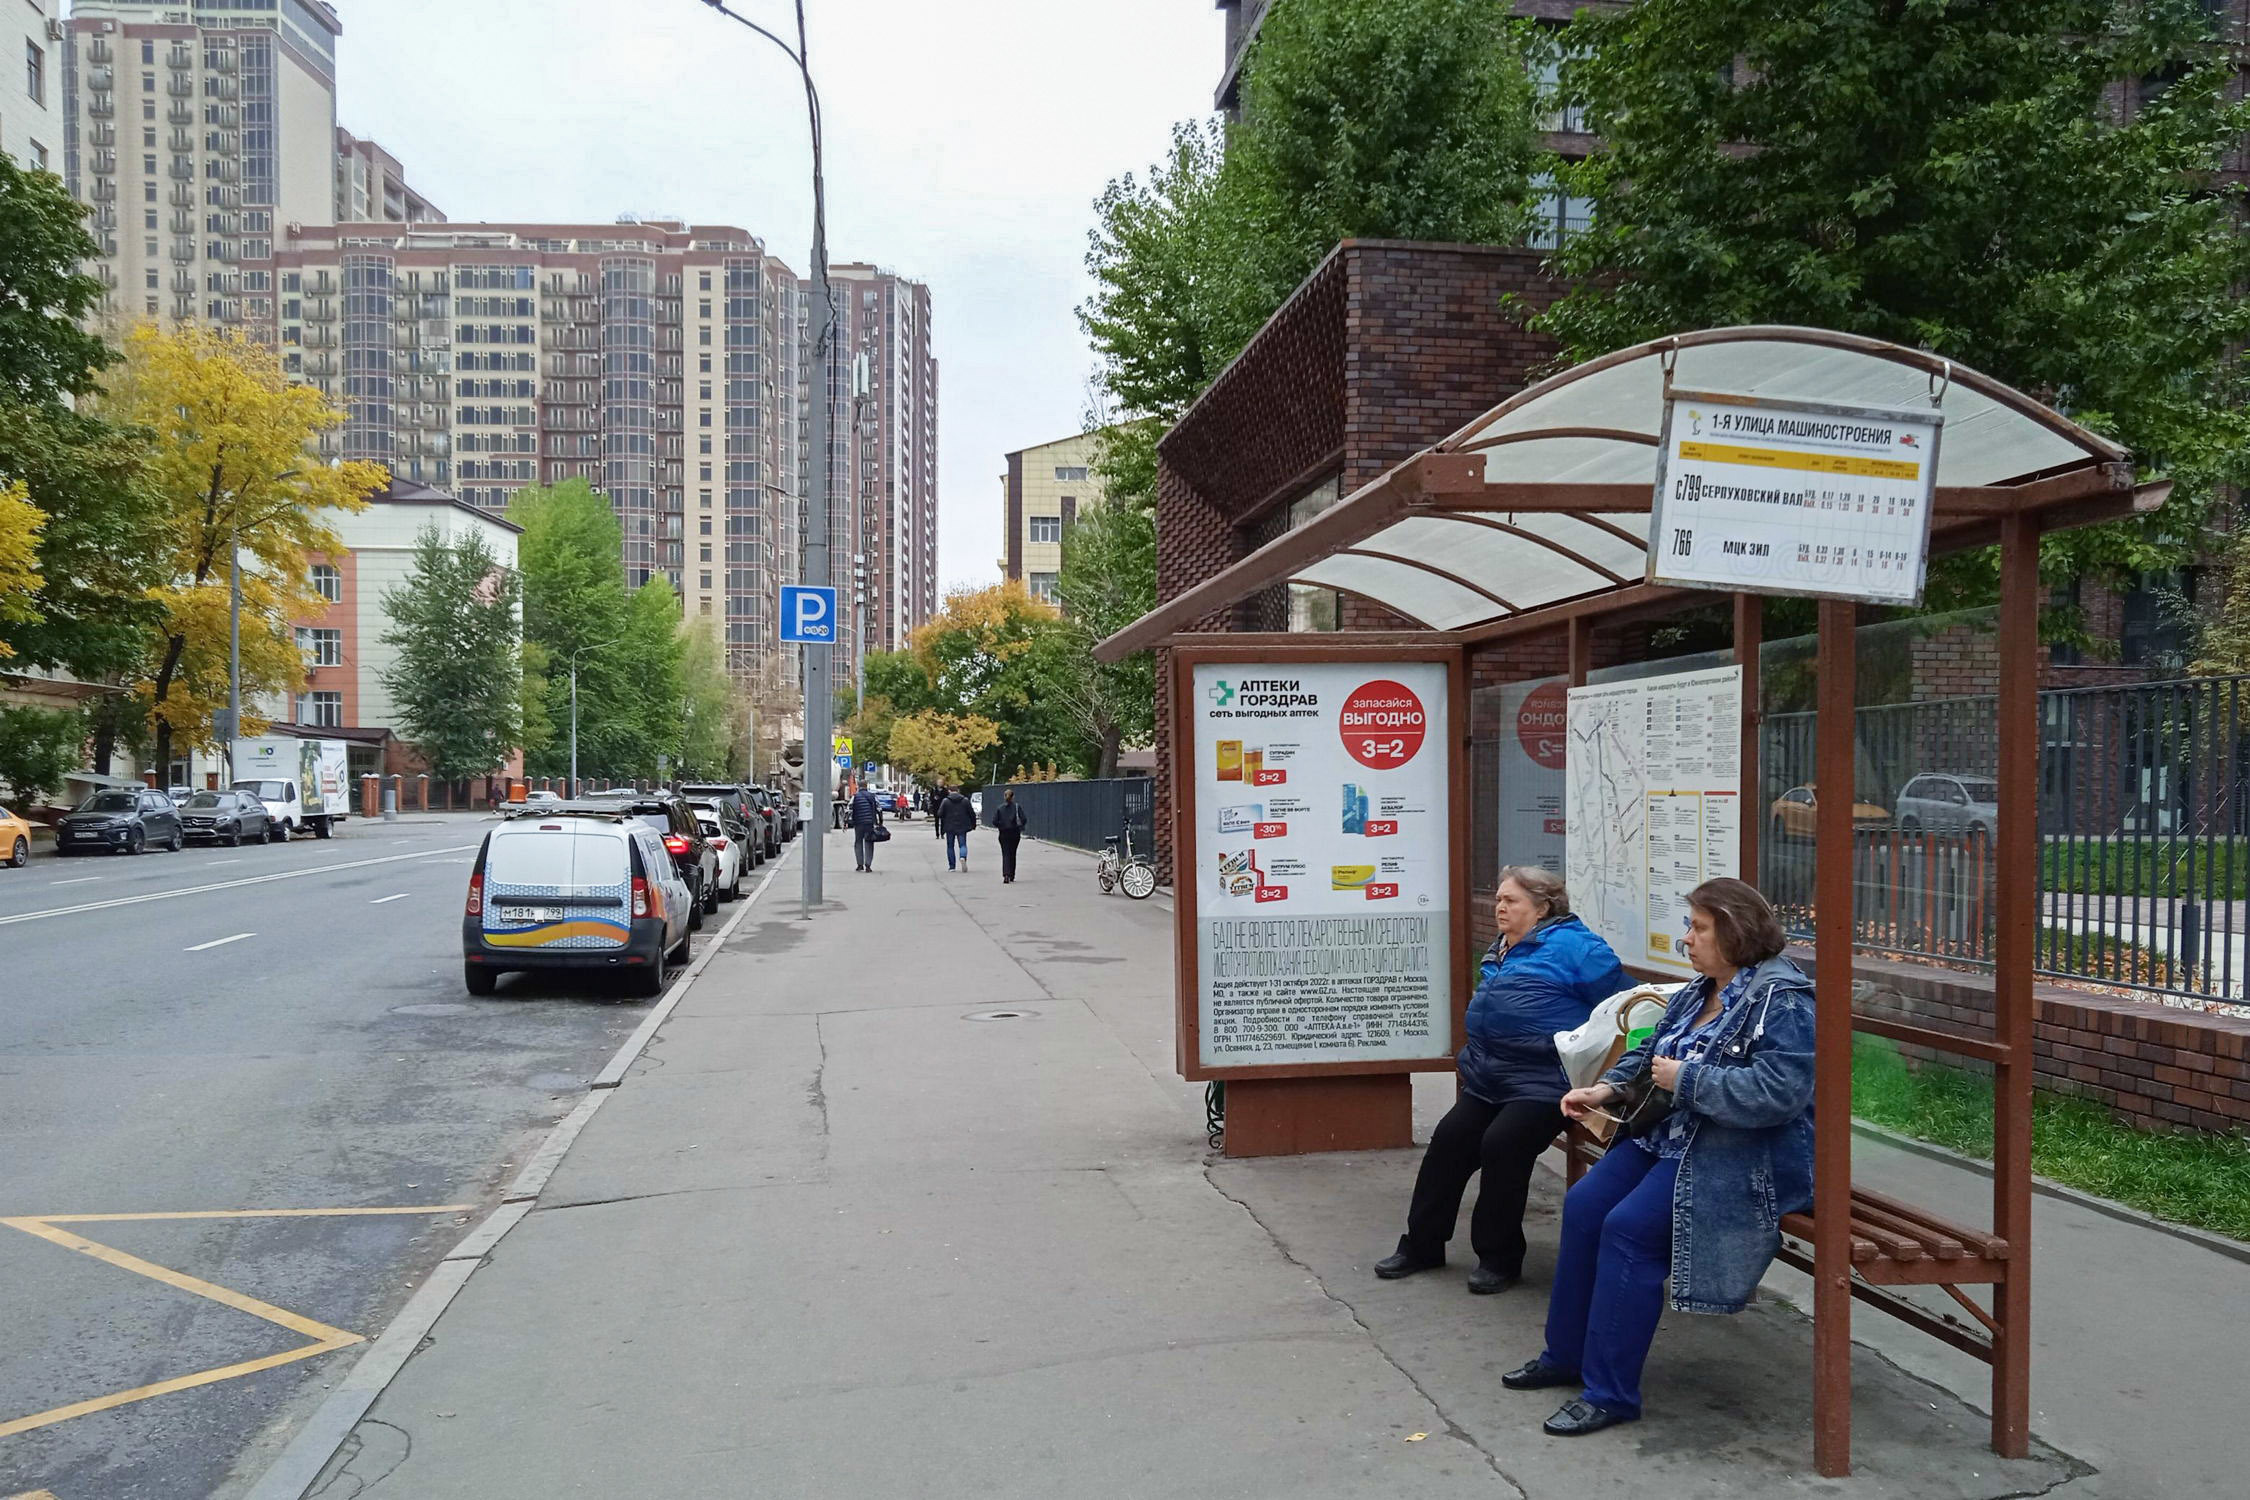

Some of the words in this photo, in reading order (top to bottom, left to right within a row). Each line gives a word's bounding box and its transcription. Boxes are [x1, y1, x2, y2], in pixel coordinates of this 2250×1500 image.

[1713, 413, 1732, 429] 1-Я
[1735, 415, 1774, 435] УЛИЦА
[1777, 419, 1892, 445] МАШИНОСТРОЕНИЯ
[1702, 485, 1781, 504] СЕРПУХОВСКИЙ
[1782, 492, 1804, 506] ВАЛ
[1672, 528, 1693, 556] 766
[1723, 540, 1747, 556] МЦК
[1749, 543, 1770, 557] ЗИЛ
[796, 592, 827, 636] P
[1240, 680, 1300, 692] АПТЕКИ
[1240, 694, 1318, 707] ГОРЗДРАВ
[1353, 697, 1413, 708] запасайся
[1209, 710, 1233, 718] сеть
[1235, 710, 1287, 718] выгодных
[1289, 709, 1319, 717] аптек
[1343, 712, 1423, 727] ВЫГОДНО
[1361, 739, 1405, 758] 3=2
[840, 757, 849, 768] P
[1259, 772, 1280, 782] 3=2
[1370, 823, 1391, 833] 3=2
[1261, 889, 1281, 899] 3=2
[1371, 886, 1392, 896] 3=2
[545, 907, 562, 916] 799
[1213, 921, 1233, 951] БАД
[1235, 921, 1246, 949] НЕ
[1249, 920, 1295, 949] ЯВЛЯЕТСЯ
[1297, 919, 1374, 948] ЛЕКАРСТВЕННЫМ
[1375, 917, 1428, 949] СРЕДСТВОМ
[1213, 980, 1233, 989] Акция
[1234, 980, 1268, 989] действует
[1269, 979, 1281, 987] 1-31
[1283, 979, 1309, 988] октября
[1364, 976, 1397, 984] ГОРЗДРАВ
[1342, 986, 1380, 994] Настоящее
[1384, 985, 1428, 993] предложение
[1256, 997, 1292, 1007] публичной
[1366, 995, 1388, 1003] товара
[1213, 1008, 1255, 1017] Организатор
[1287, 1005, 1339, 1015] одностороннем
[1341, 1004, 1368, 1013] порядке
[1403, 1002, 1429, 1010] условия
[1243, 1016, 1290, 1024] Подробности
[1312, 1014, 1346, 1022] телефону
[1353, 1012, 1393, 1021] справочной
[1284, 1023, 1299, 1031] ООО
[1213, 1035, 1231, 1043] ОГРН
[1291, 1032, 1337, 1041] Юридический
[1274, 1041, 1313, 1050] помещение
